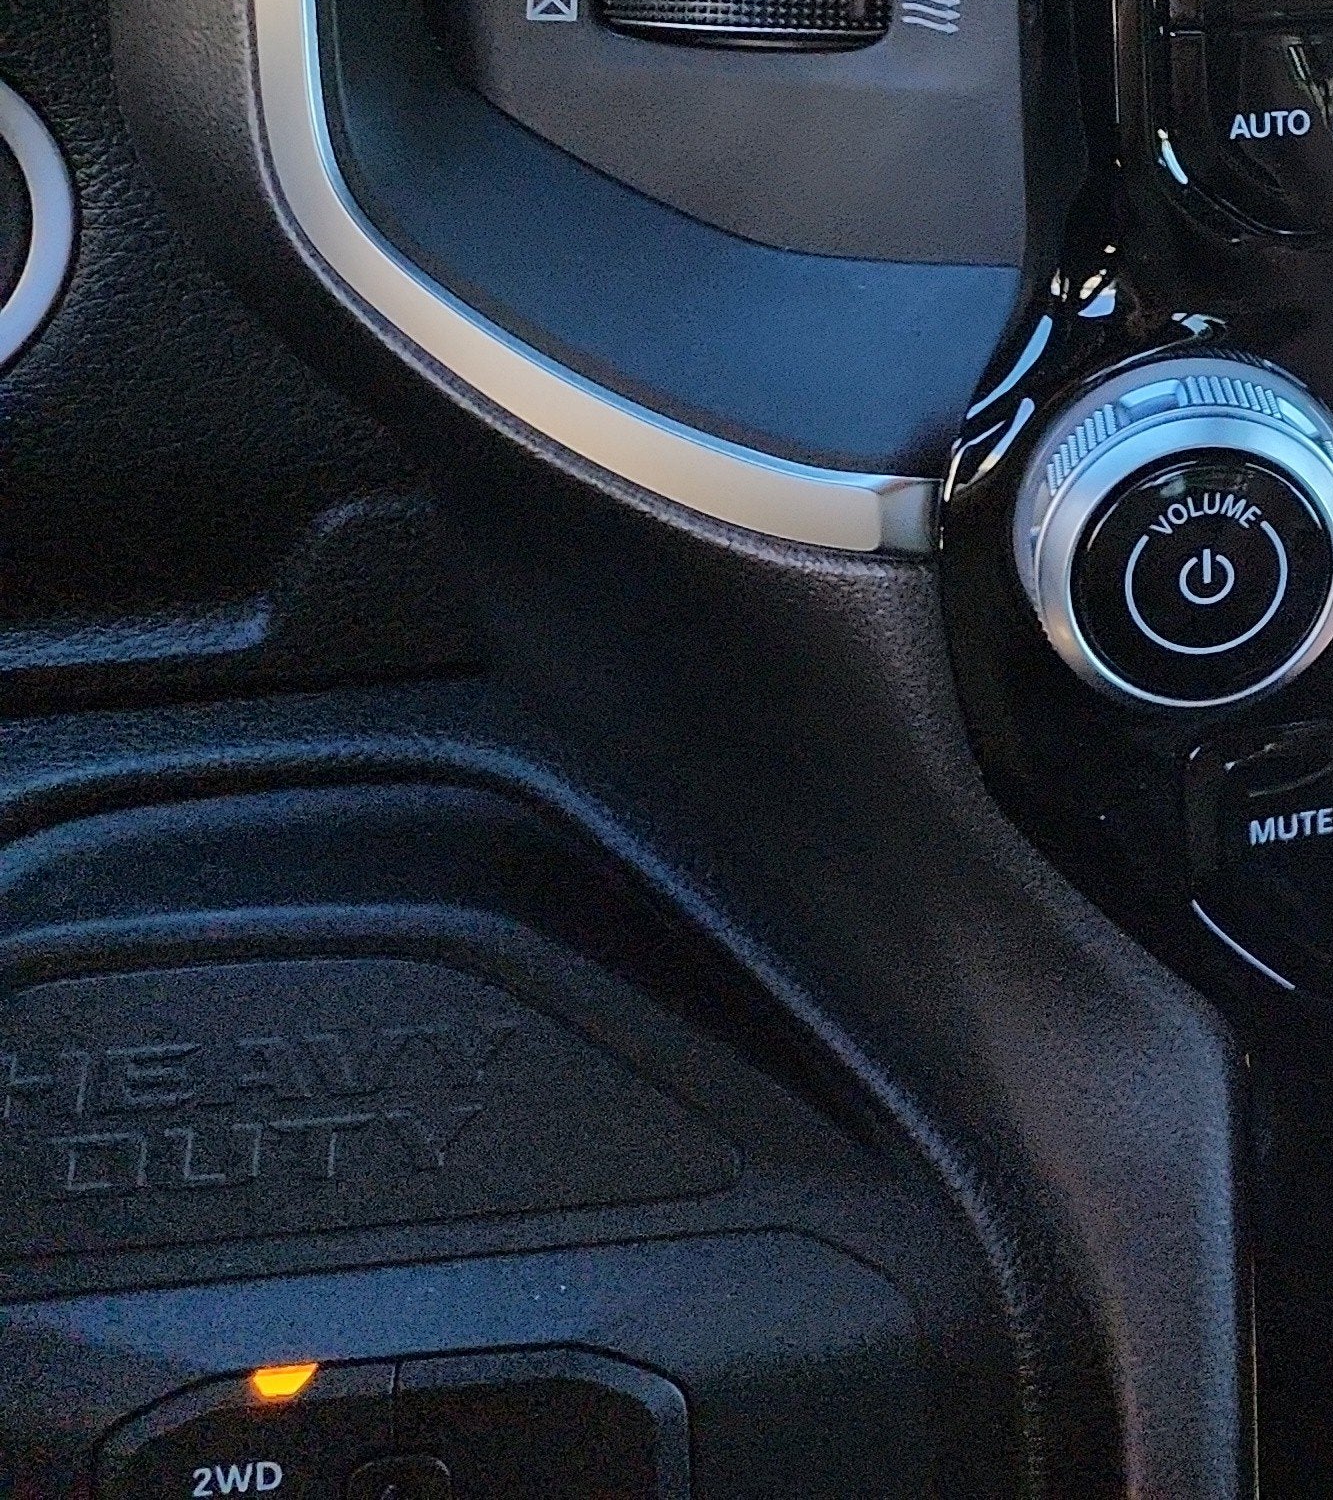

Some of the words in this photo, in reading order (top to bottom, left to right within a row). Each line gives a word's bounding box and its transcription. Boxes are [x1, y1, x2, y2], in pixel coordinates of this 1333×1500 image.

[1229, 109, 1311, 140] AUTO
[1149, 492, 1262, 536] VOLUME
[1249, 807, 1333, 846] MUTE
[192, 1461, 284, 1497] 2WD
